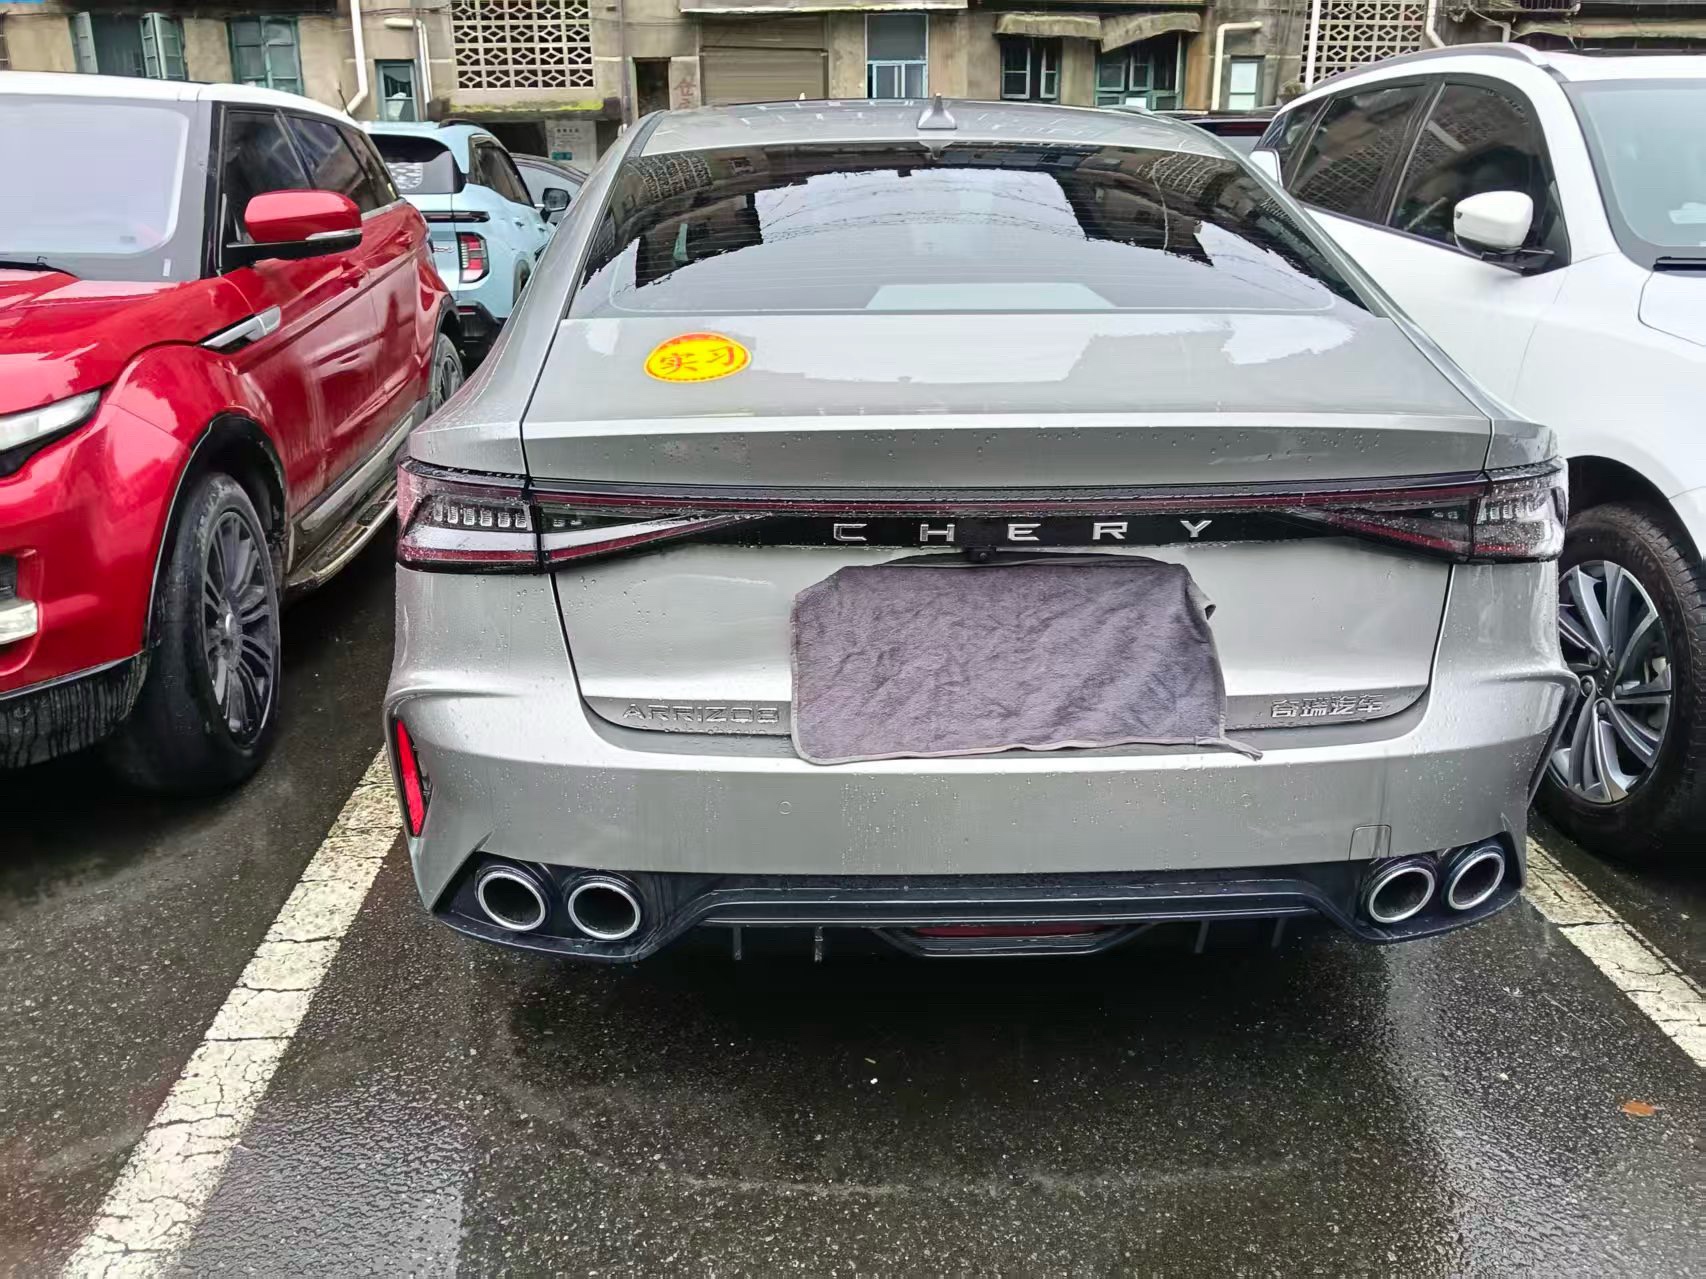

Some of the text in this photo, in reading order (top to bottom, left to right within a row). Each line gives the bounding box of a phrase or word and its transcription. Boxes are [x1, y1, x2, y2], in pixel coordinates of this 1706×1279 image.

[660, 346, 735, 375] 实习
[833, 520, 1212, 542] CHERY
[1271, 694, 1384, 717] 奇瑞汽车
